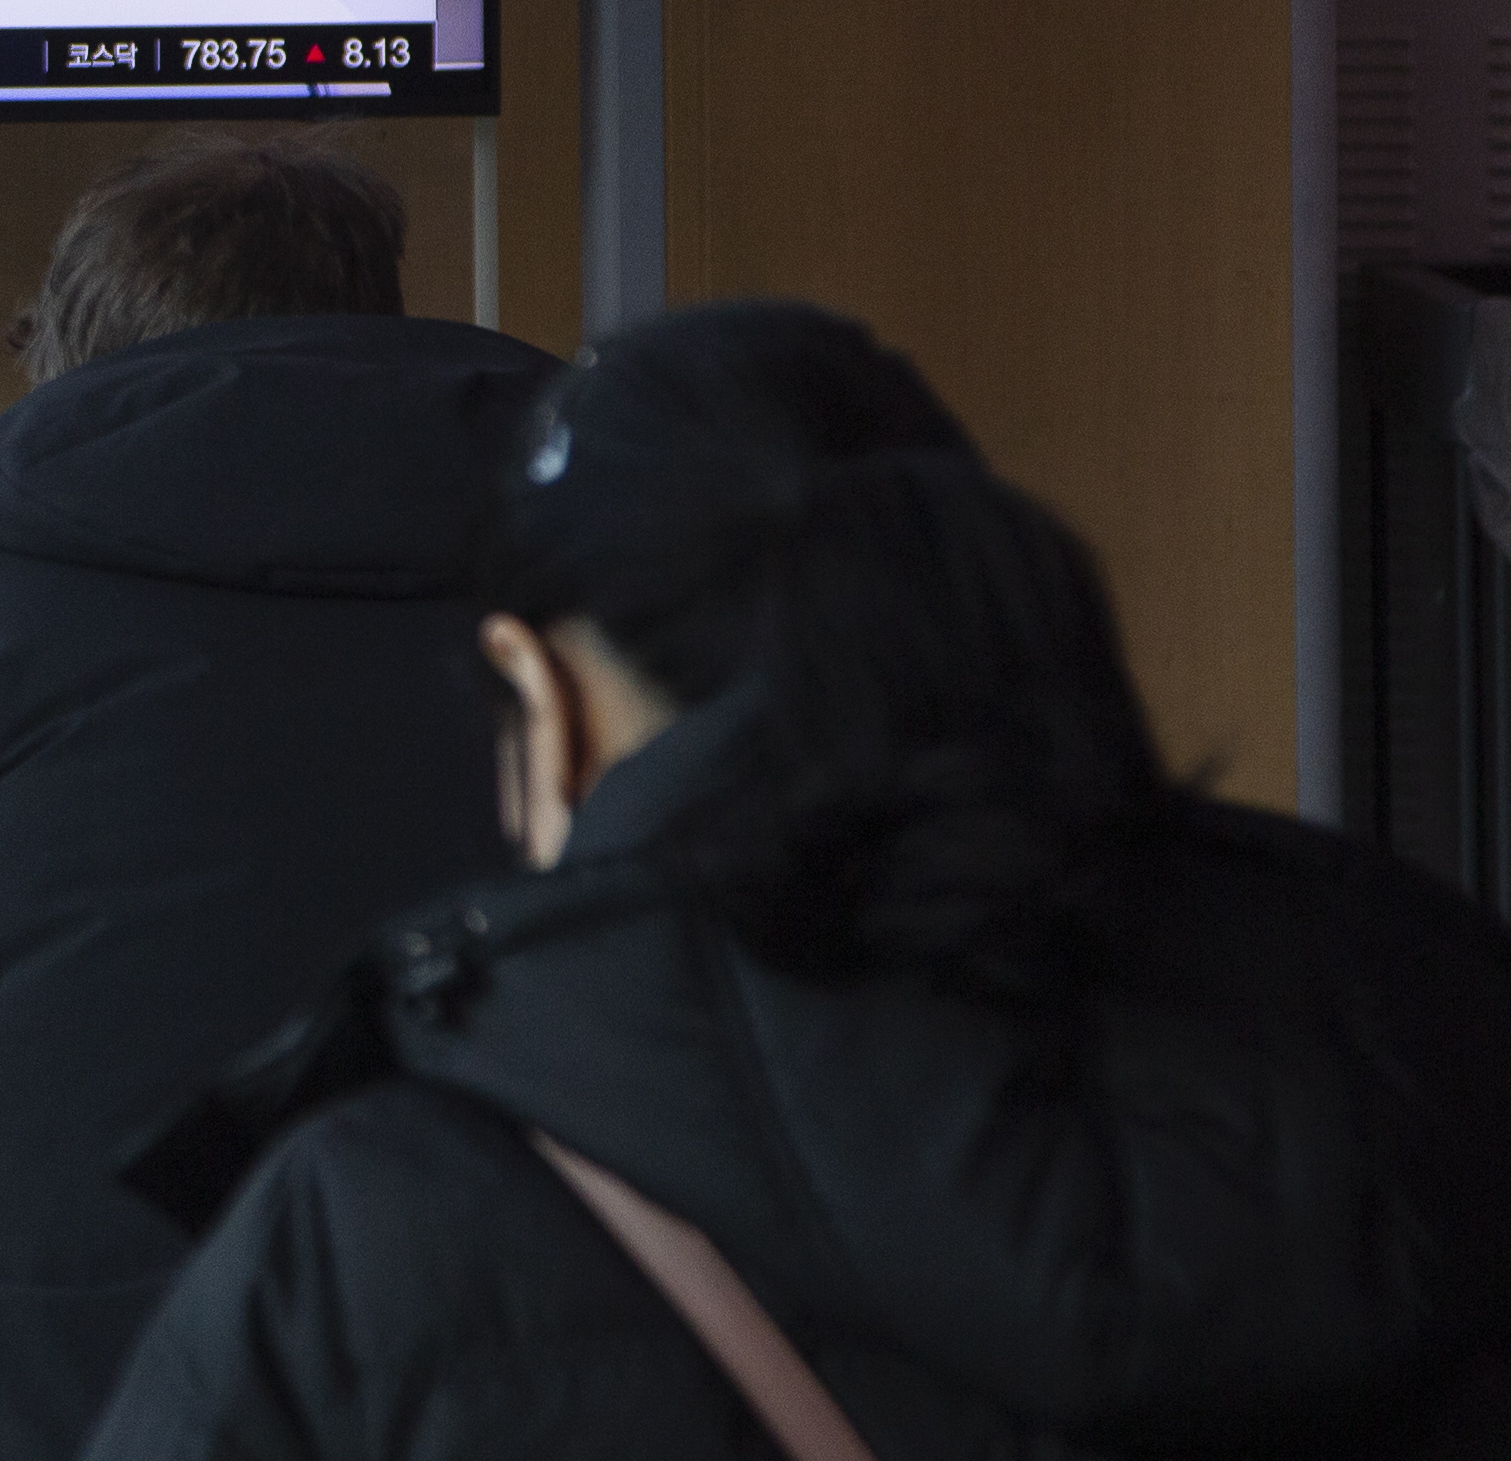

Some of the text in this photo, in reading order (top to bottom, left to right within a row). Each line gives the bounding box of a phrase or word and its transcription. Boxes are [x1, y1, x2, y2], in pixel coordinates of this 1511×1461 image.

[67, 37, 411, 70] 코스닥 783.75 8.13
